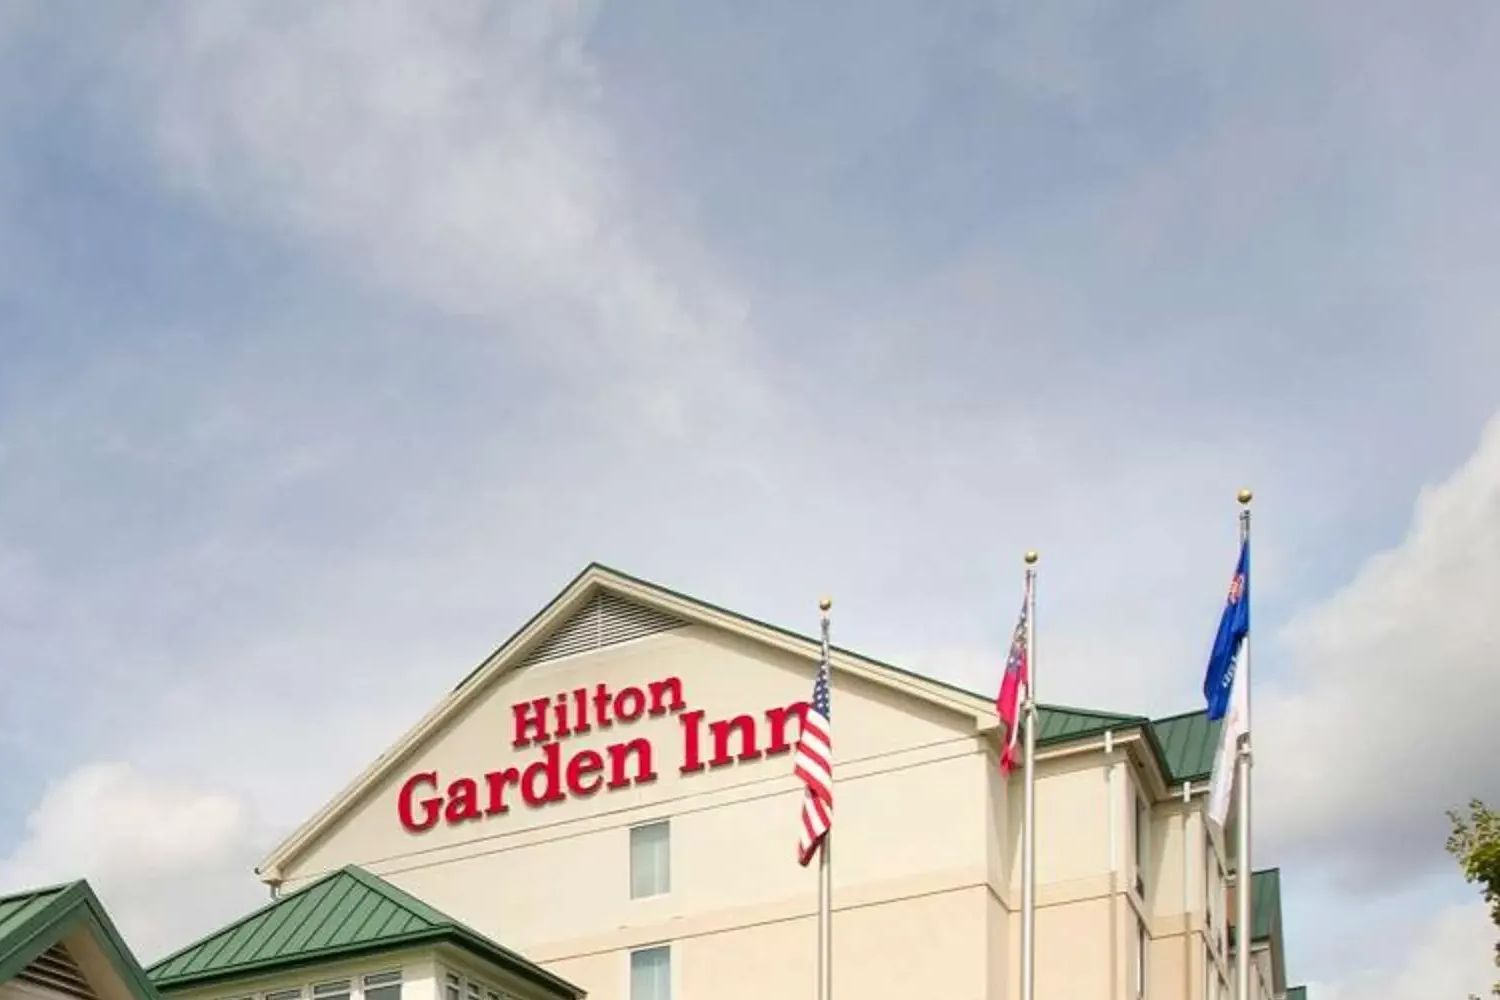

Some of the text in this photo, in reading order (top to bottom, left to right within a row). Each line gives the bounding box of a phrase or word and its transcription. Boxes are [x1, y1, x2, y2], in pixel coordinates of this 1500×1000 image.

[512, 676, 686, 748] Hilton
[398, 702, 812, 833] Garden Inn
